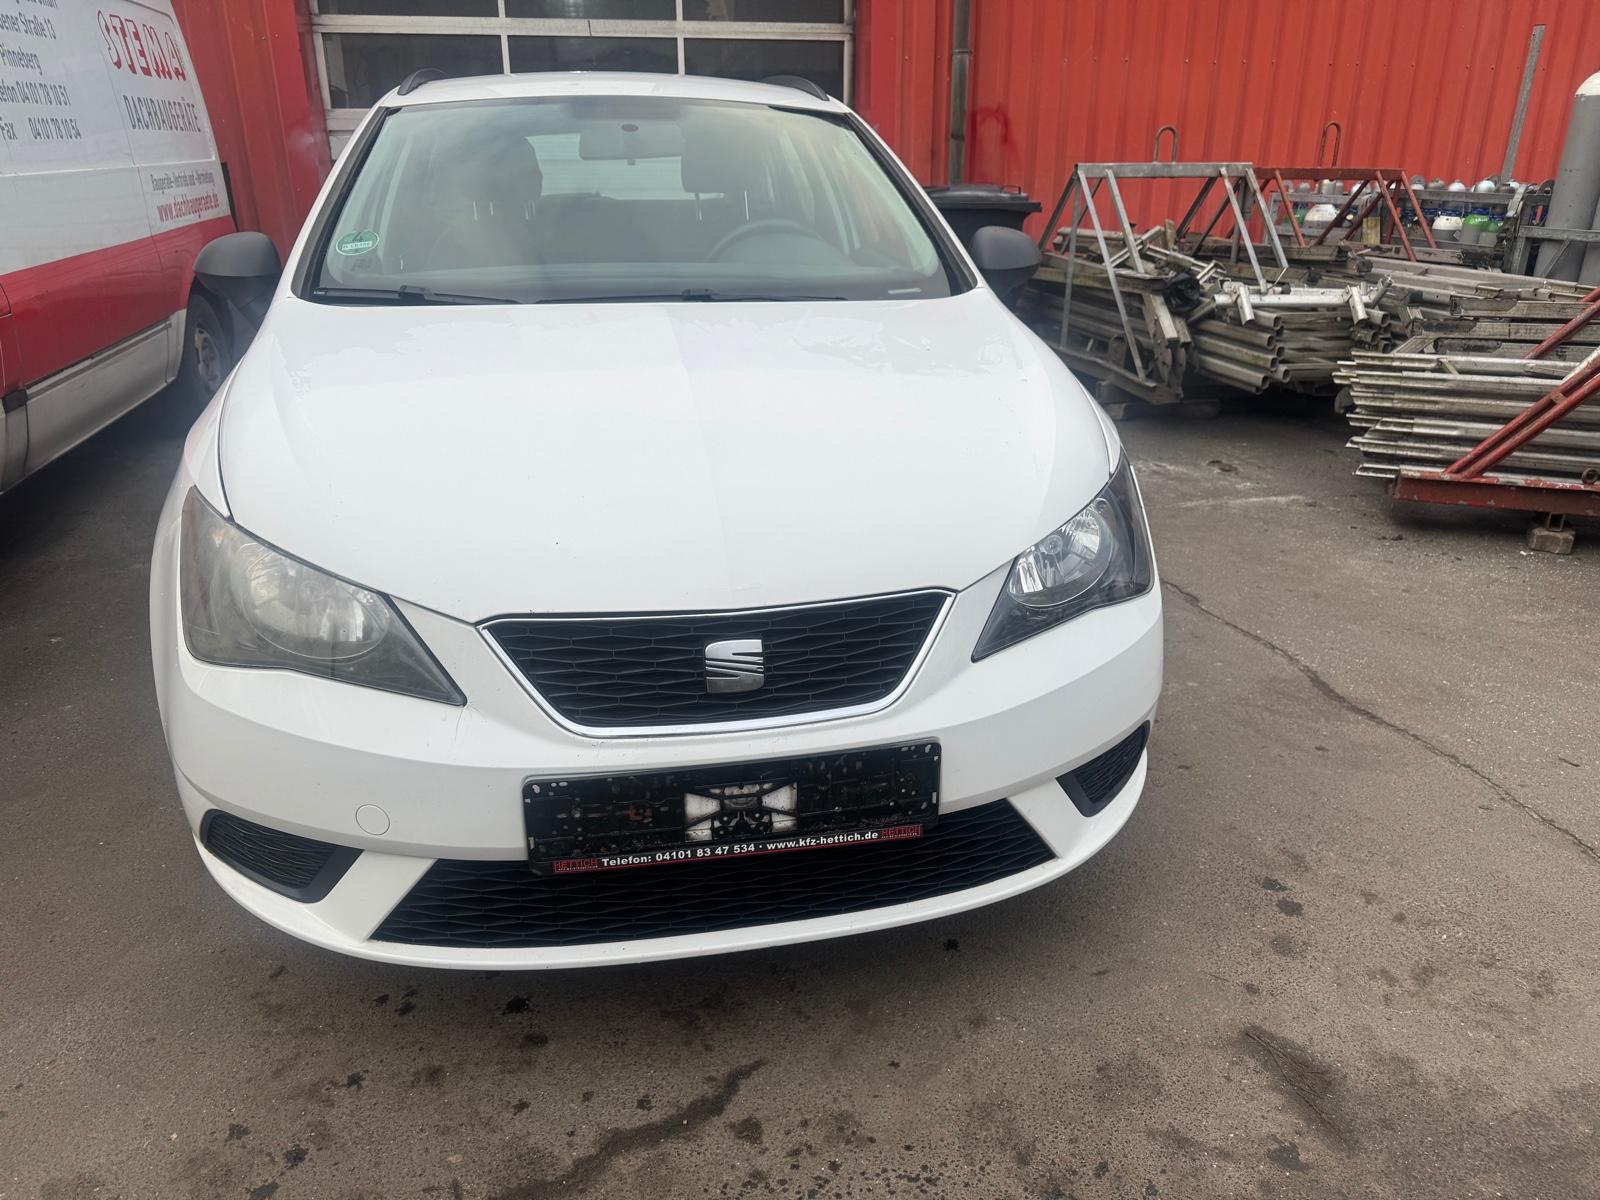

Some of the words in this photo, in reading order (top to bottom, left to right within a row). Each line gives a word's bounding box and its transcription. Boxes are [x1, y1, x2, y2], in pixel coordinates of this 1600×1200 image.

[18, 11, 47, 38] Straße
[43, 16, 57, 40] 13
[97, 9, 187, 82] STEMA
[0, 79, 20, 103] efon
[15, 80, 43, 105] 04101
[28, 116, 54, 140] 04101
[122, 94, 202, 133] DACHBAUGERÄTE
[602, 856, 652, 867] Telefon:
[655, 850, 692, 861] 04101
[696, 847, 711, 858] 83
[715, 846, 730, 855] 47
[733, 844, 755, 854] 534
[767, 831, 879, 850] www.kfz-hettich.de
